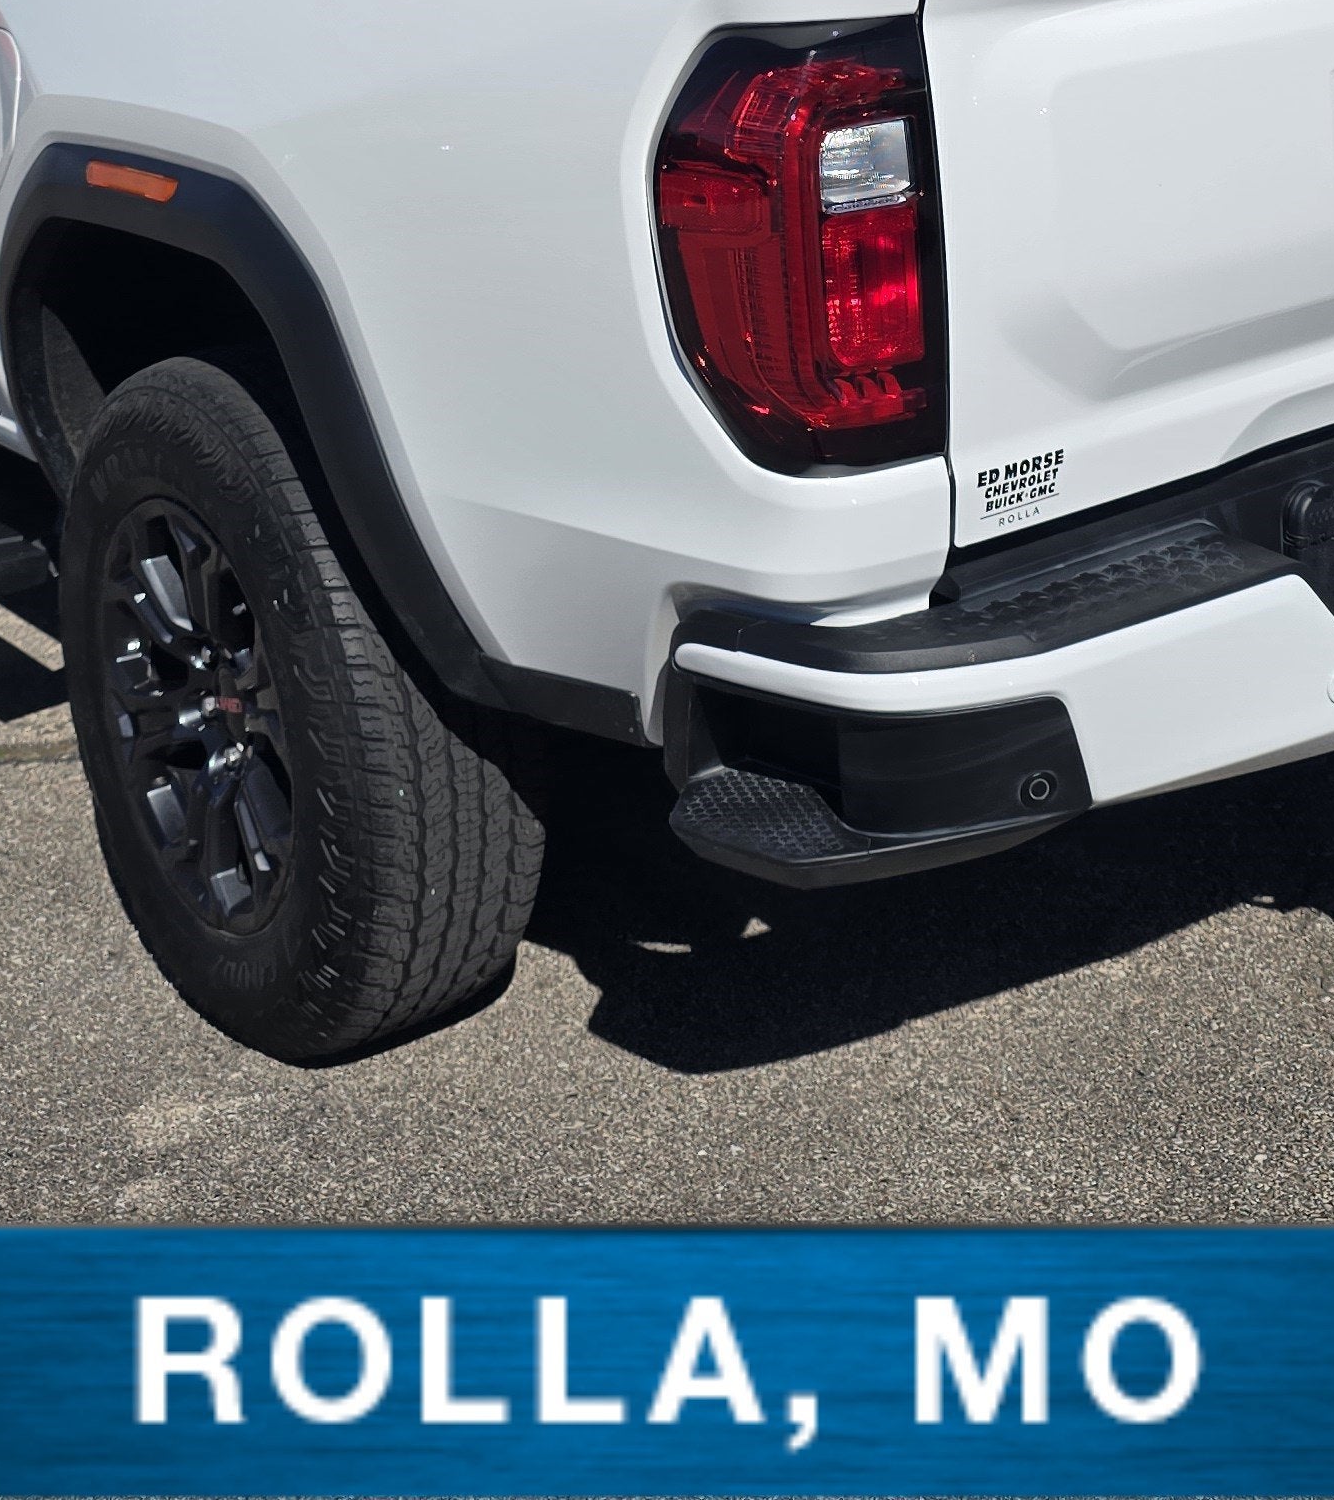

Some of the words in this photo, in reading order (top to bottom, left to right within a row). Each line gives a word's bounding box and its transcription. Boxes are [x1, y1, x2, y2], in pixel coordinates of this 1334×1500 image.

[977, 467, 1000, 488] ED
[1004, 448, 1065, 481] MORSE
[984, 467, 1059, 499] CHEVROLET
[998, 506, 1041, 527] ROLLA
